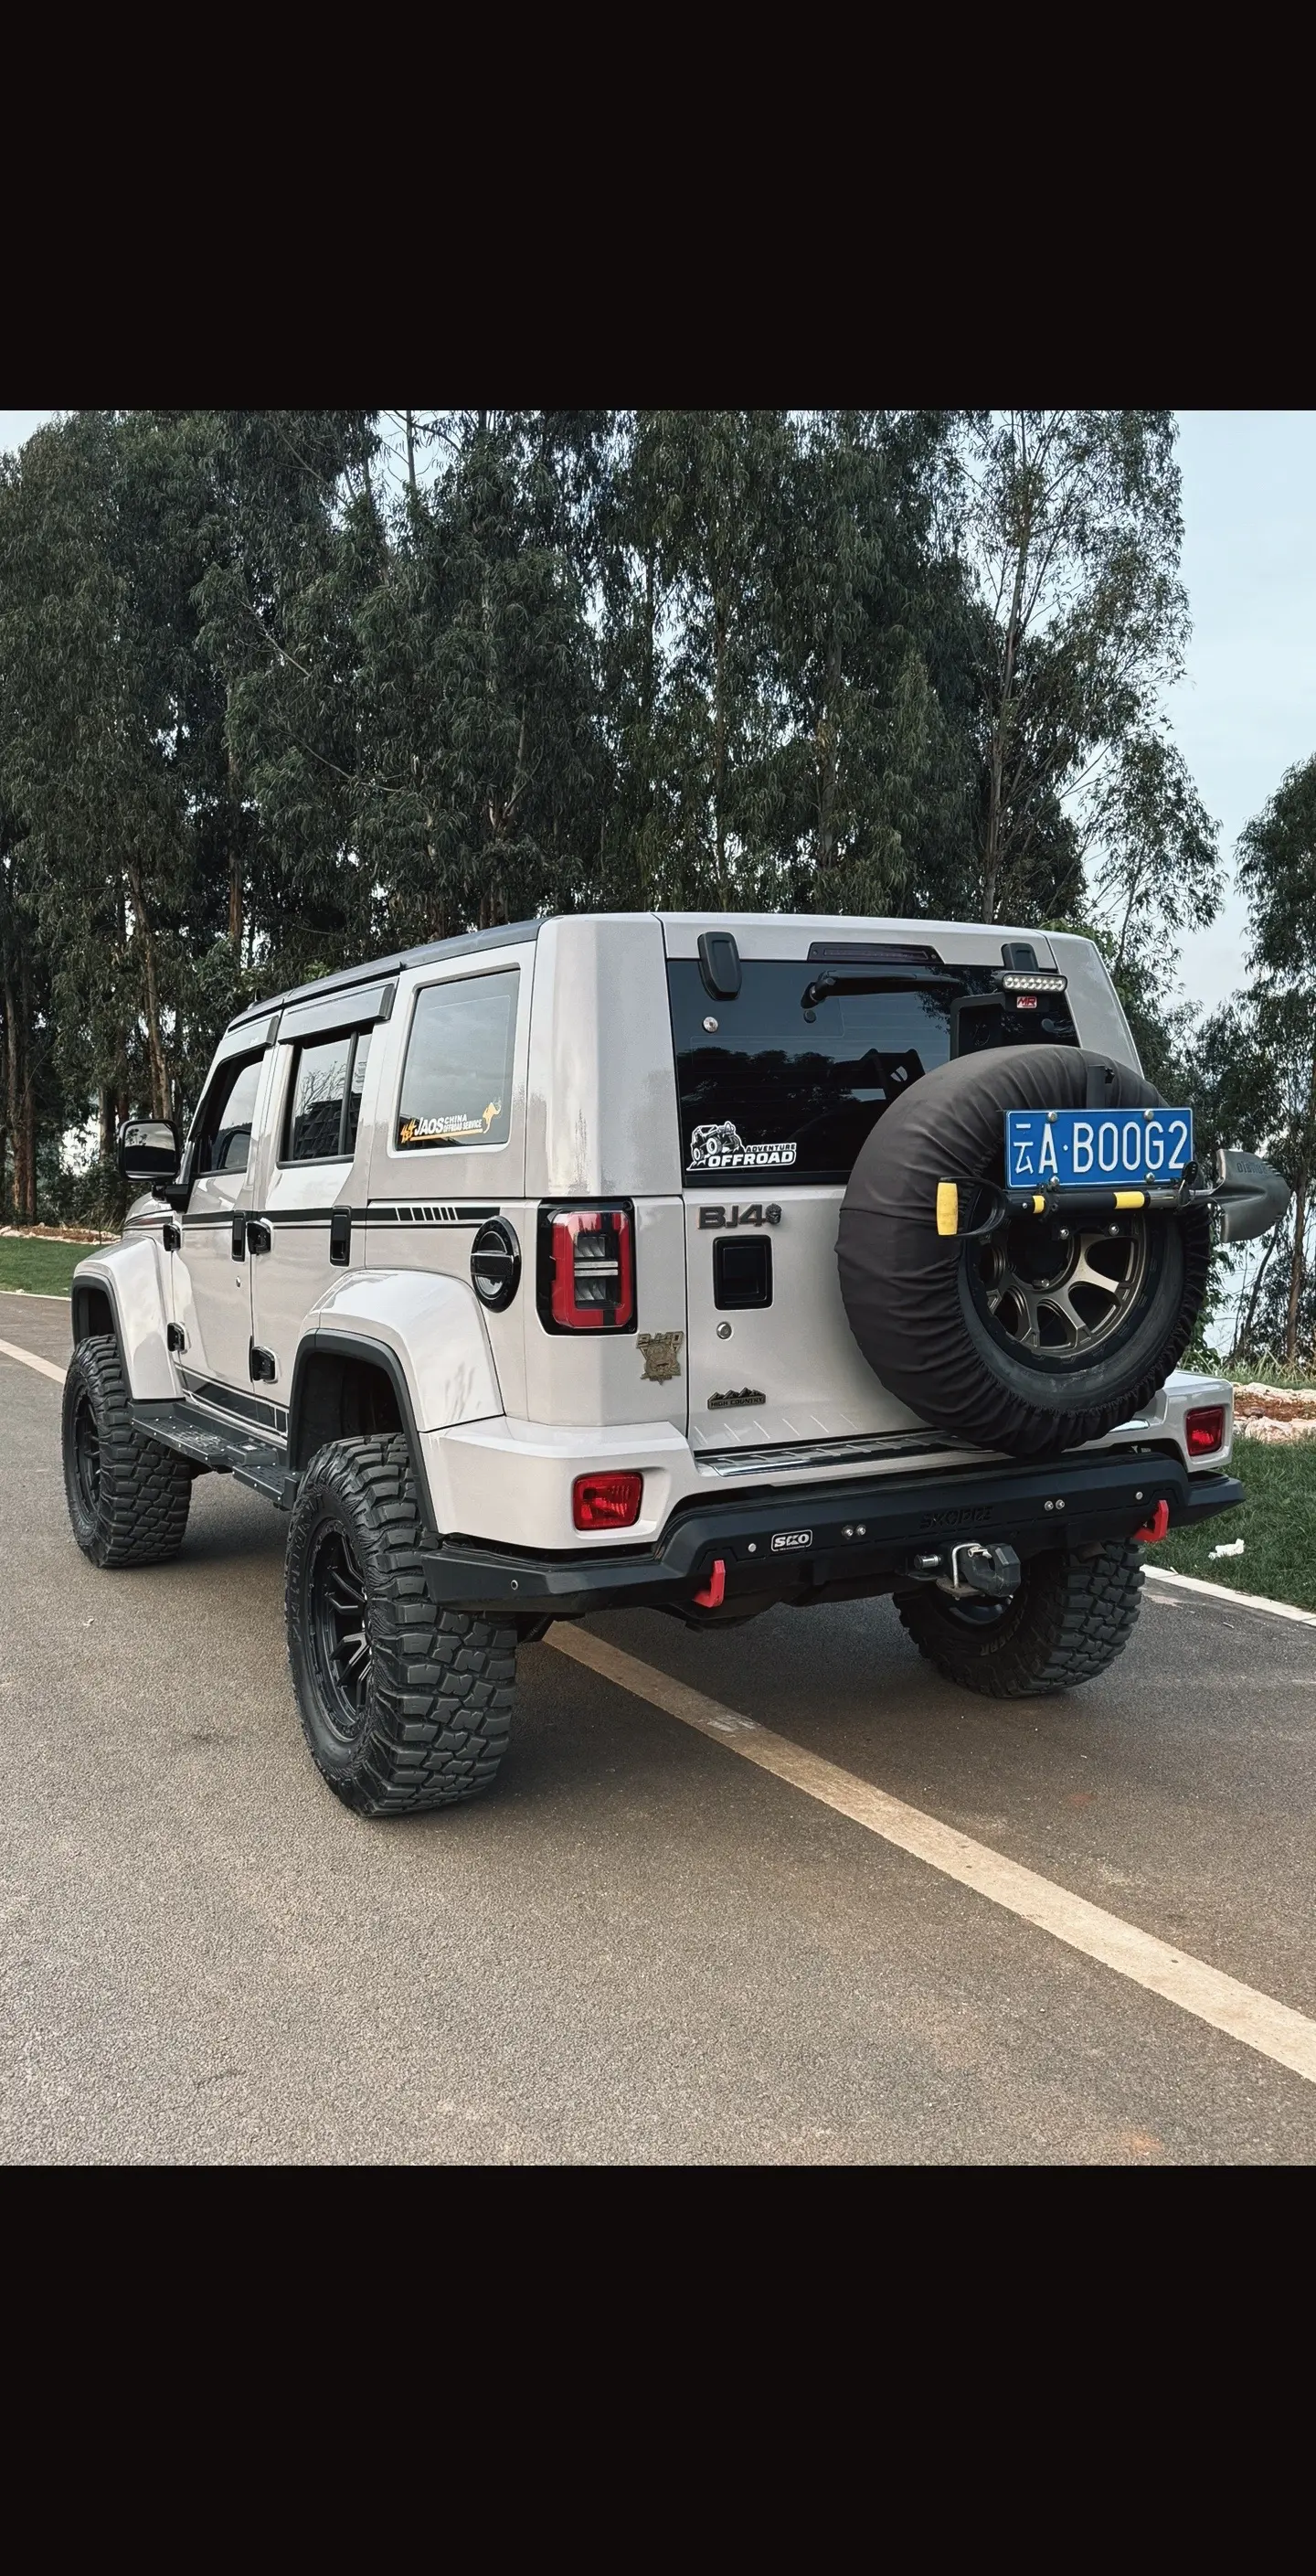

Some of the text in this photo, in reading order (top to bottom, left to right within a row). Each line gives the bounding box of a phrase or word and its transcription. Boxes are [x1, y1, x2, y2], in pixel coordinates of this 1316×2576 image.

[414, 1116, 444, 1135] JAOS
[444, 1113, 468, 1124] CHINA
[462, 1119, 483, 1131] SERVICE
[746, 1144, 796, 1153] ADVENTURE
[707, 1151, 794, 1167] OFFROAD
[730, 1397, 764, 1405] COUNTRY
[774, 1533, 810, 1548] SKO
